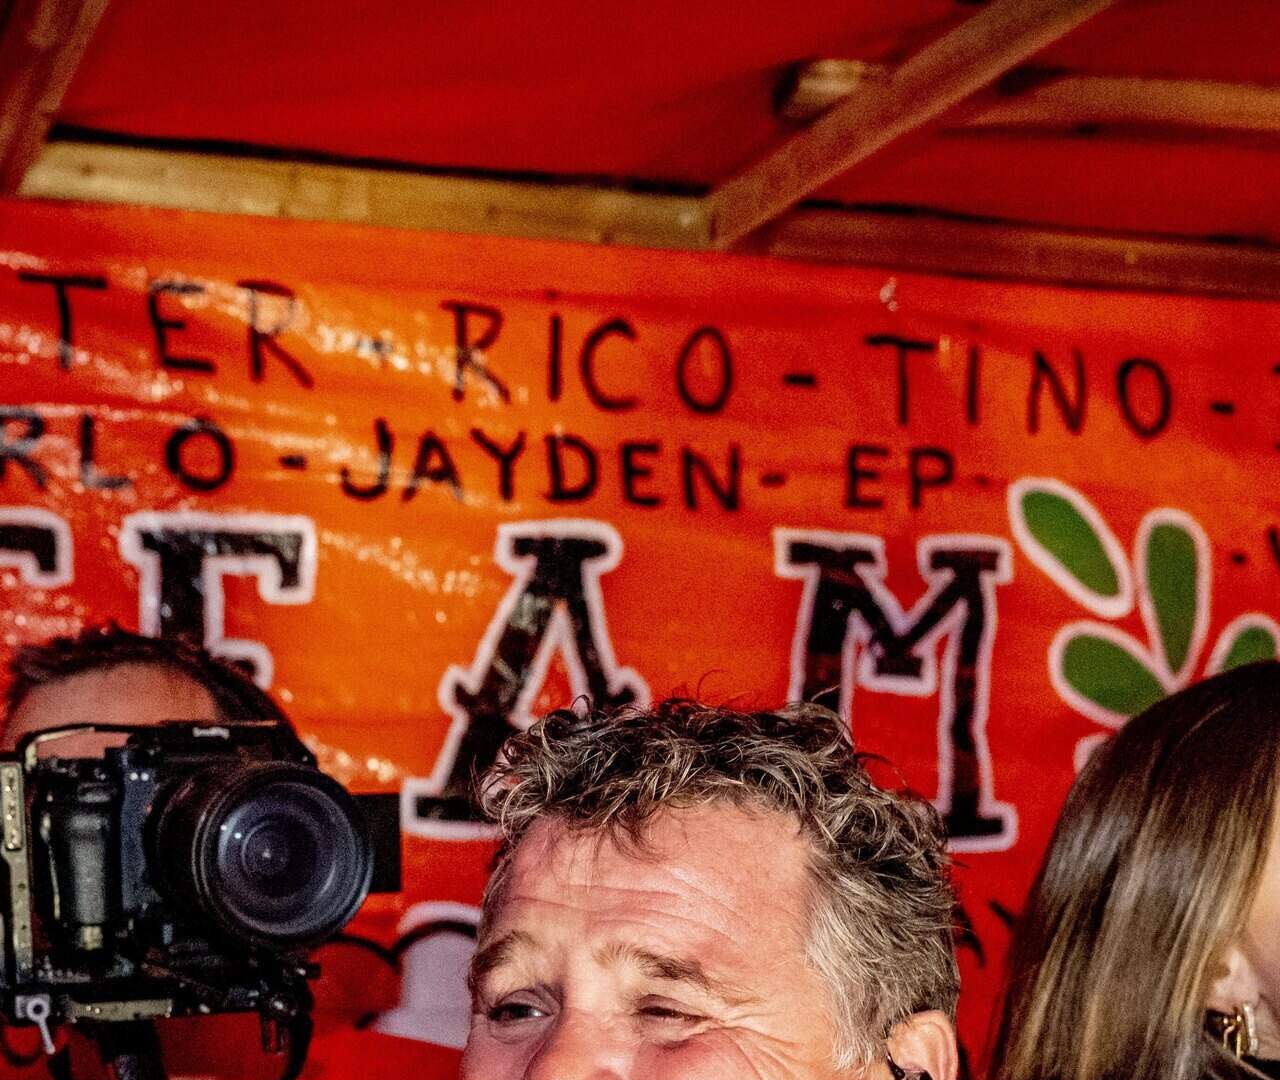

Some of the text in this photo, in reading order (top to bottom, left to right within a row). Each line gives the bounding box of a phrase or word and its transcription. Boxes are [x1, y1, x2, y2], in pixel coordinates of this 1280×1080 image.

[864, 334, 1174, 440] TINO
[339, 418, 741, 511] JAYDEN
[844, 445, 959, 510] EP
